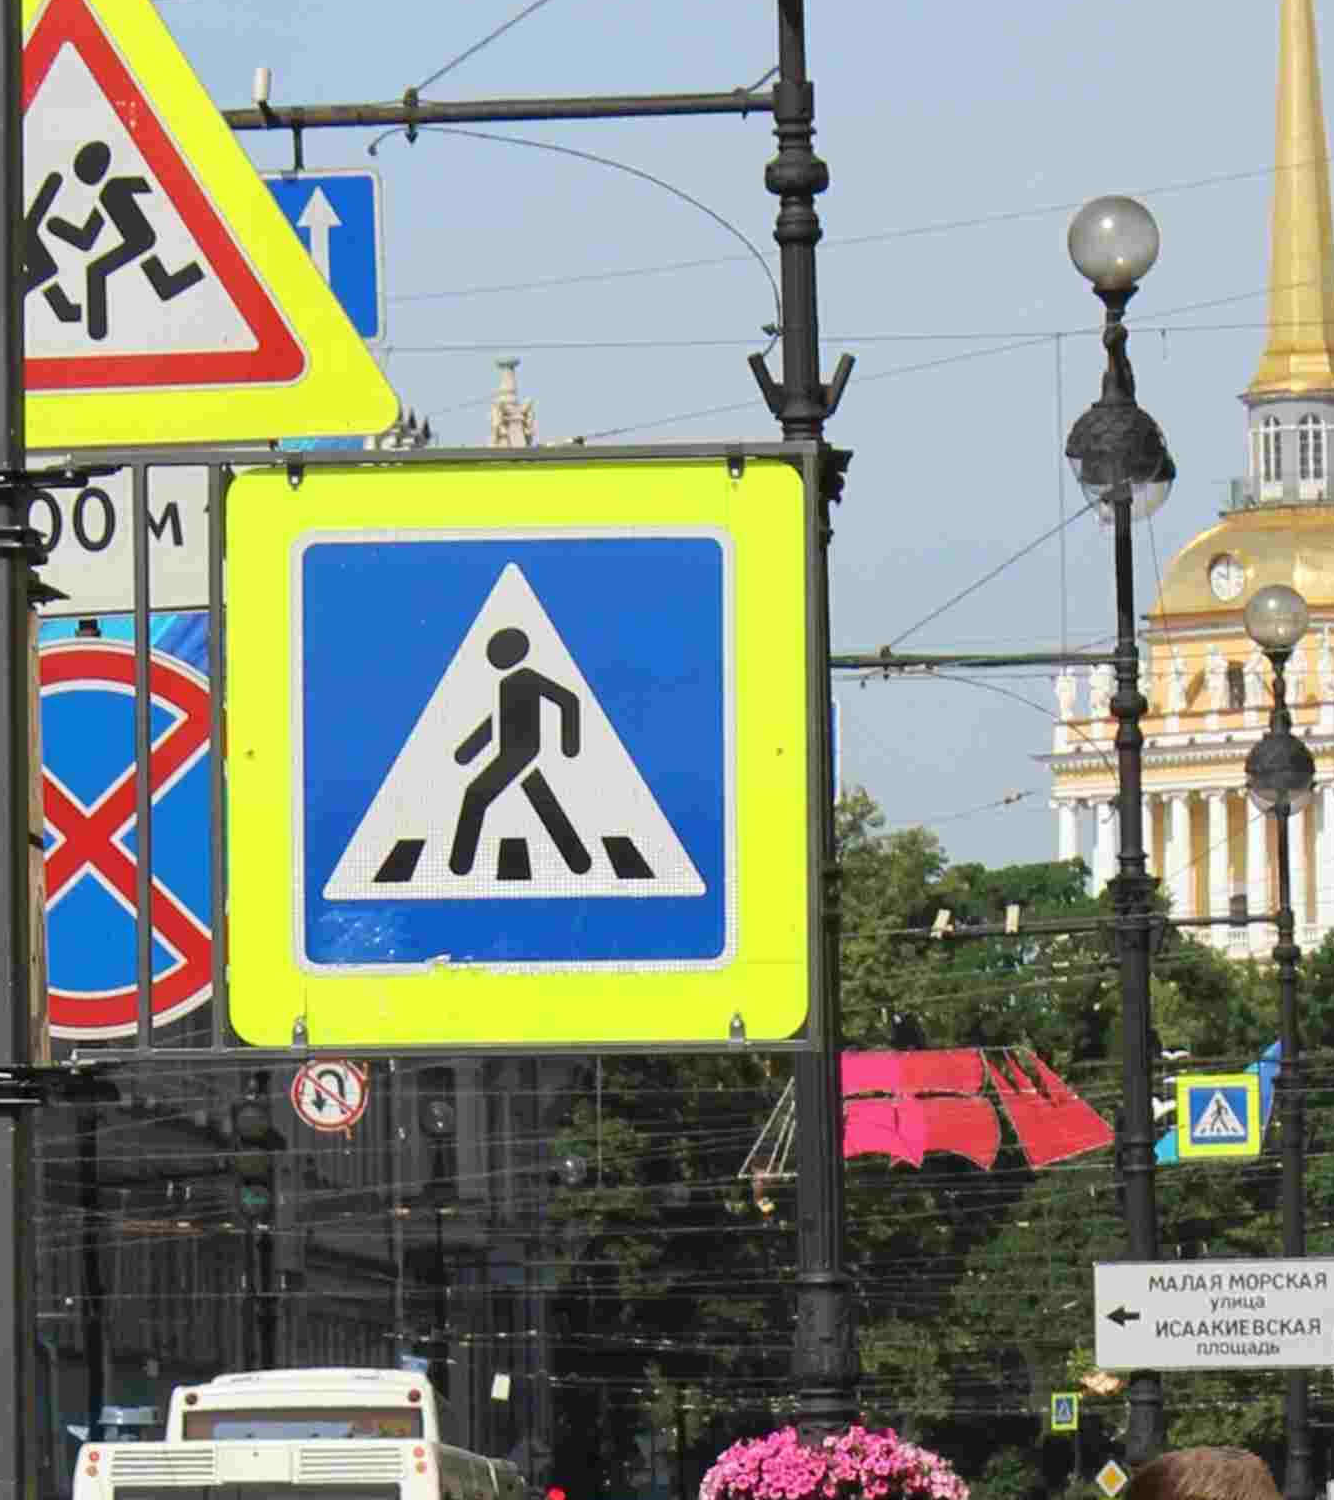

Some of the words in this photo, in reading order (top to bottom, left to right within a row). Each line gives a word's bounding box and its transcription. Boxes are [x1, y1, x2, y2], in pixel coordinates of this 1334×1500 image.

[1148, 1273, 1223, 1292] МАЛАЯ
[1229, 1272, 1328, 1290] МОРСКАЯ
[1210, 1294, 1266, 1312] улица
[1155, 1317, 1322, 1338] ИСААКИЕВСКАЯ
[1196, 1340, 1280, 1356] площадь
